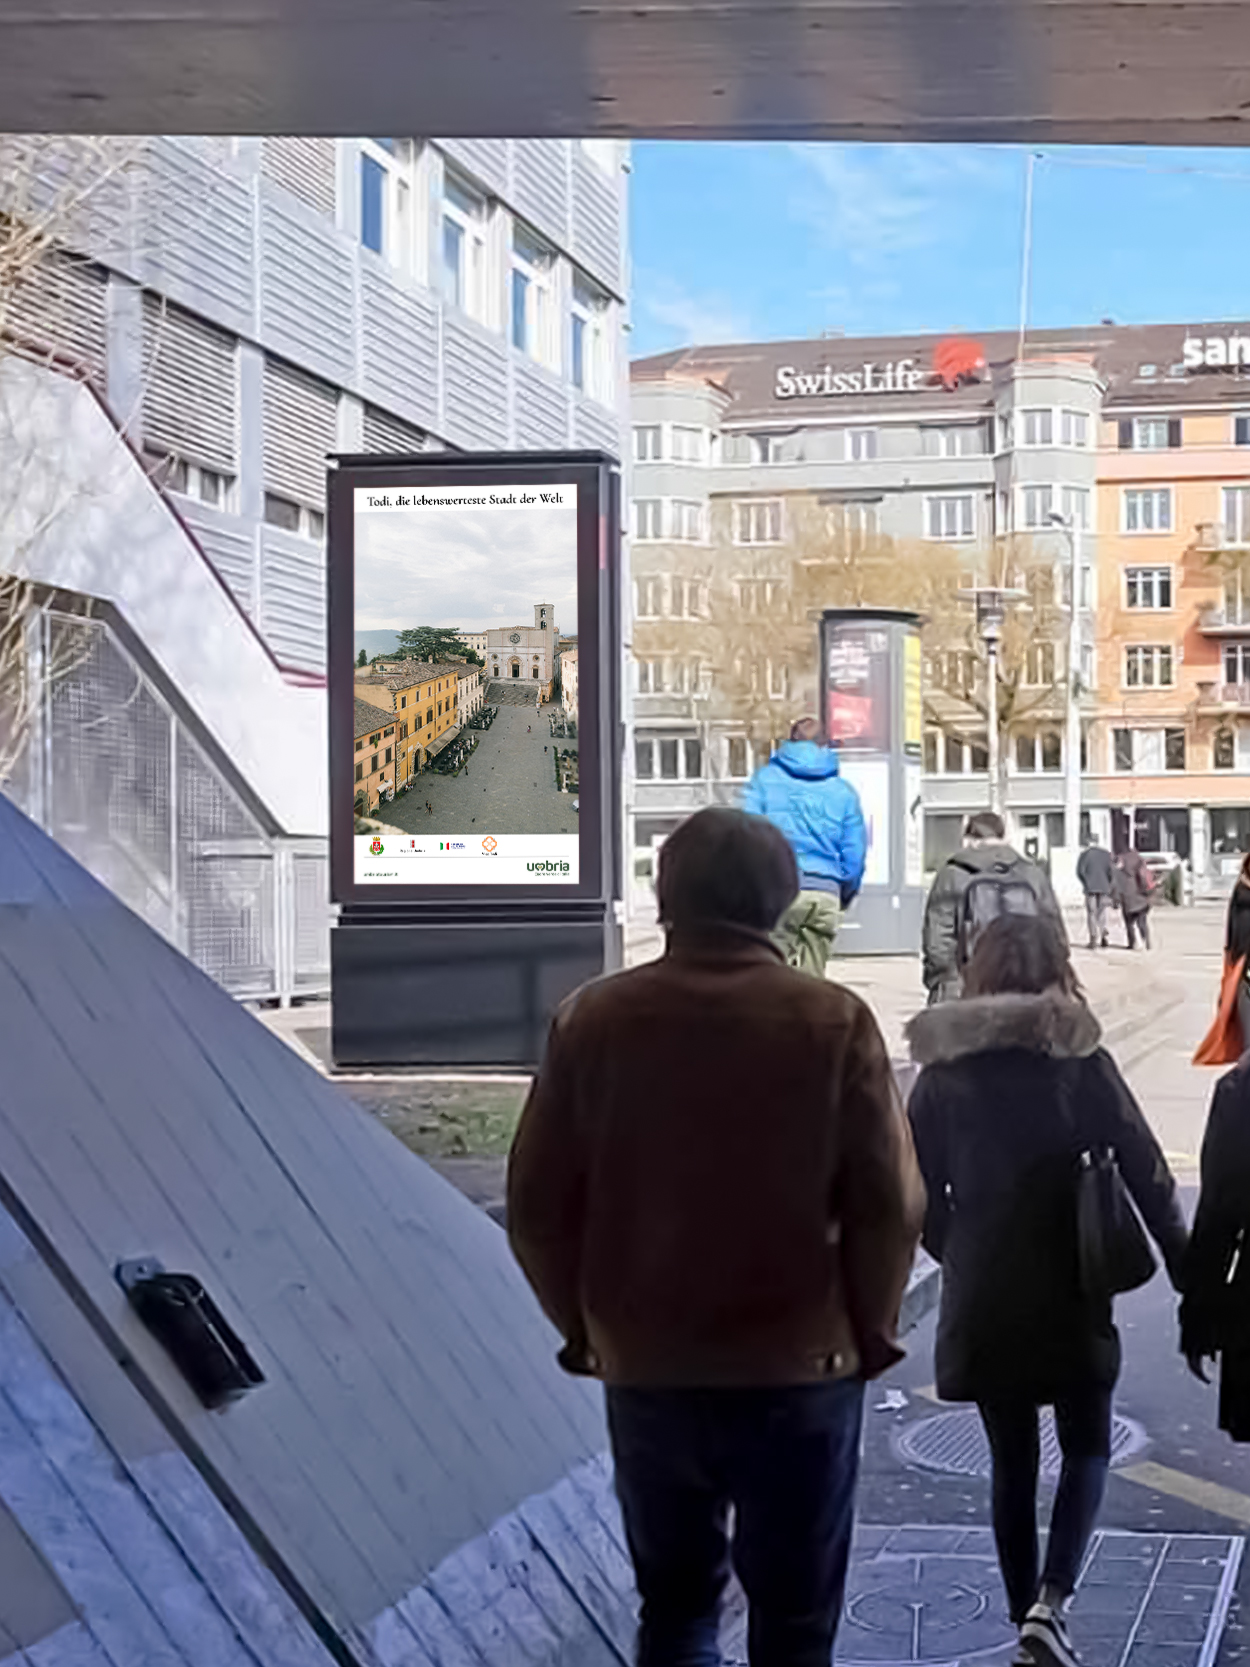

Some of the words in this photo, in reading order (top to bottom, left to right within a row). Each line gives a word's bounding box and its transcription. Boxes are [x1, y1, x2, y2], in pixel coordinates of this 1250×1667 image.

[366, 495, 393, 508] Todi,
[395, 495, 411, 506] die
[413, 494, 486, 506] lebenswerteste
[488, 493, 517, 505] Stadt
[519, 492, 537, 504] der
[539, 492, 564, 504] Welt
